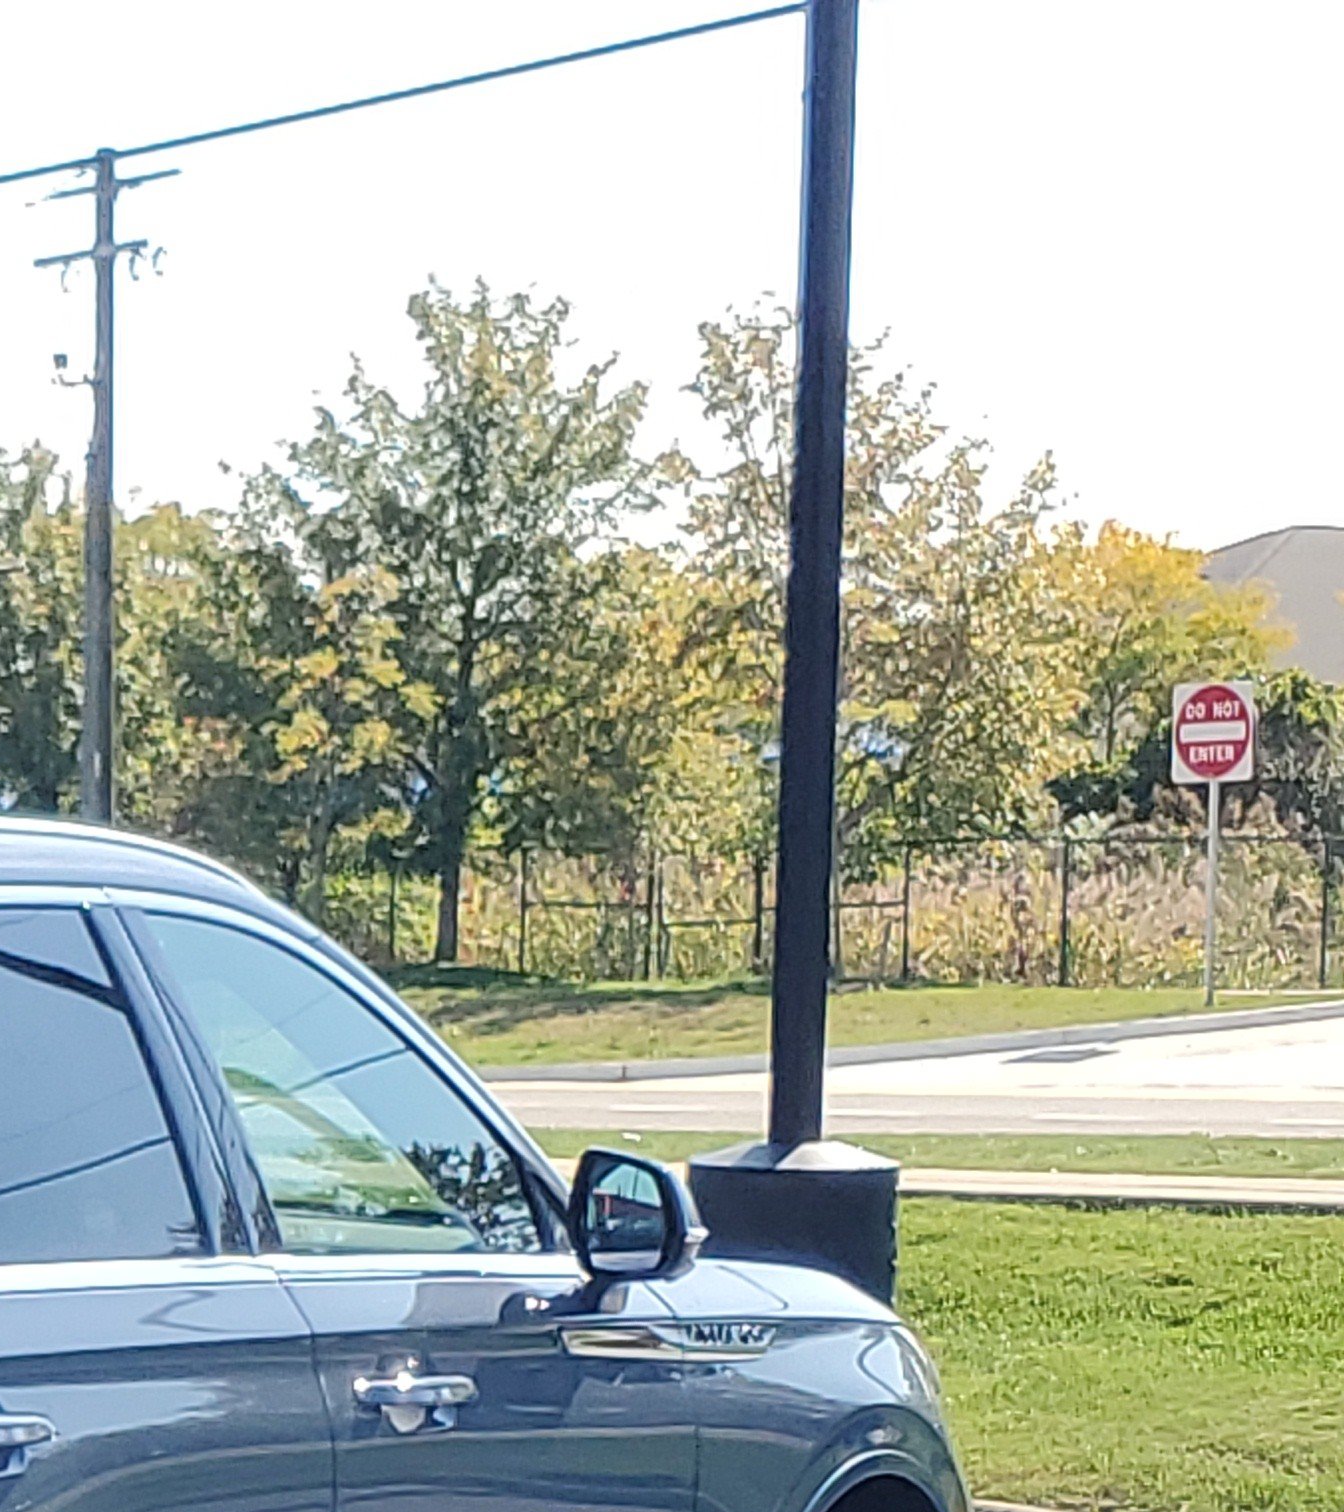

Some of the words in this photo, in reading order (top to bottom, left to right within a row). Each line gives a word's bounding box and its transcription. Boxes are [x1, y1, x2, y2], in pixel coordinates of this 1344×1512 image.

[1185, 701, 1206, 719] DO
[1213, 700, 1240, 718] NOT
[1189, 744, 1234, 763] ENTER
